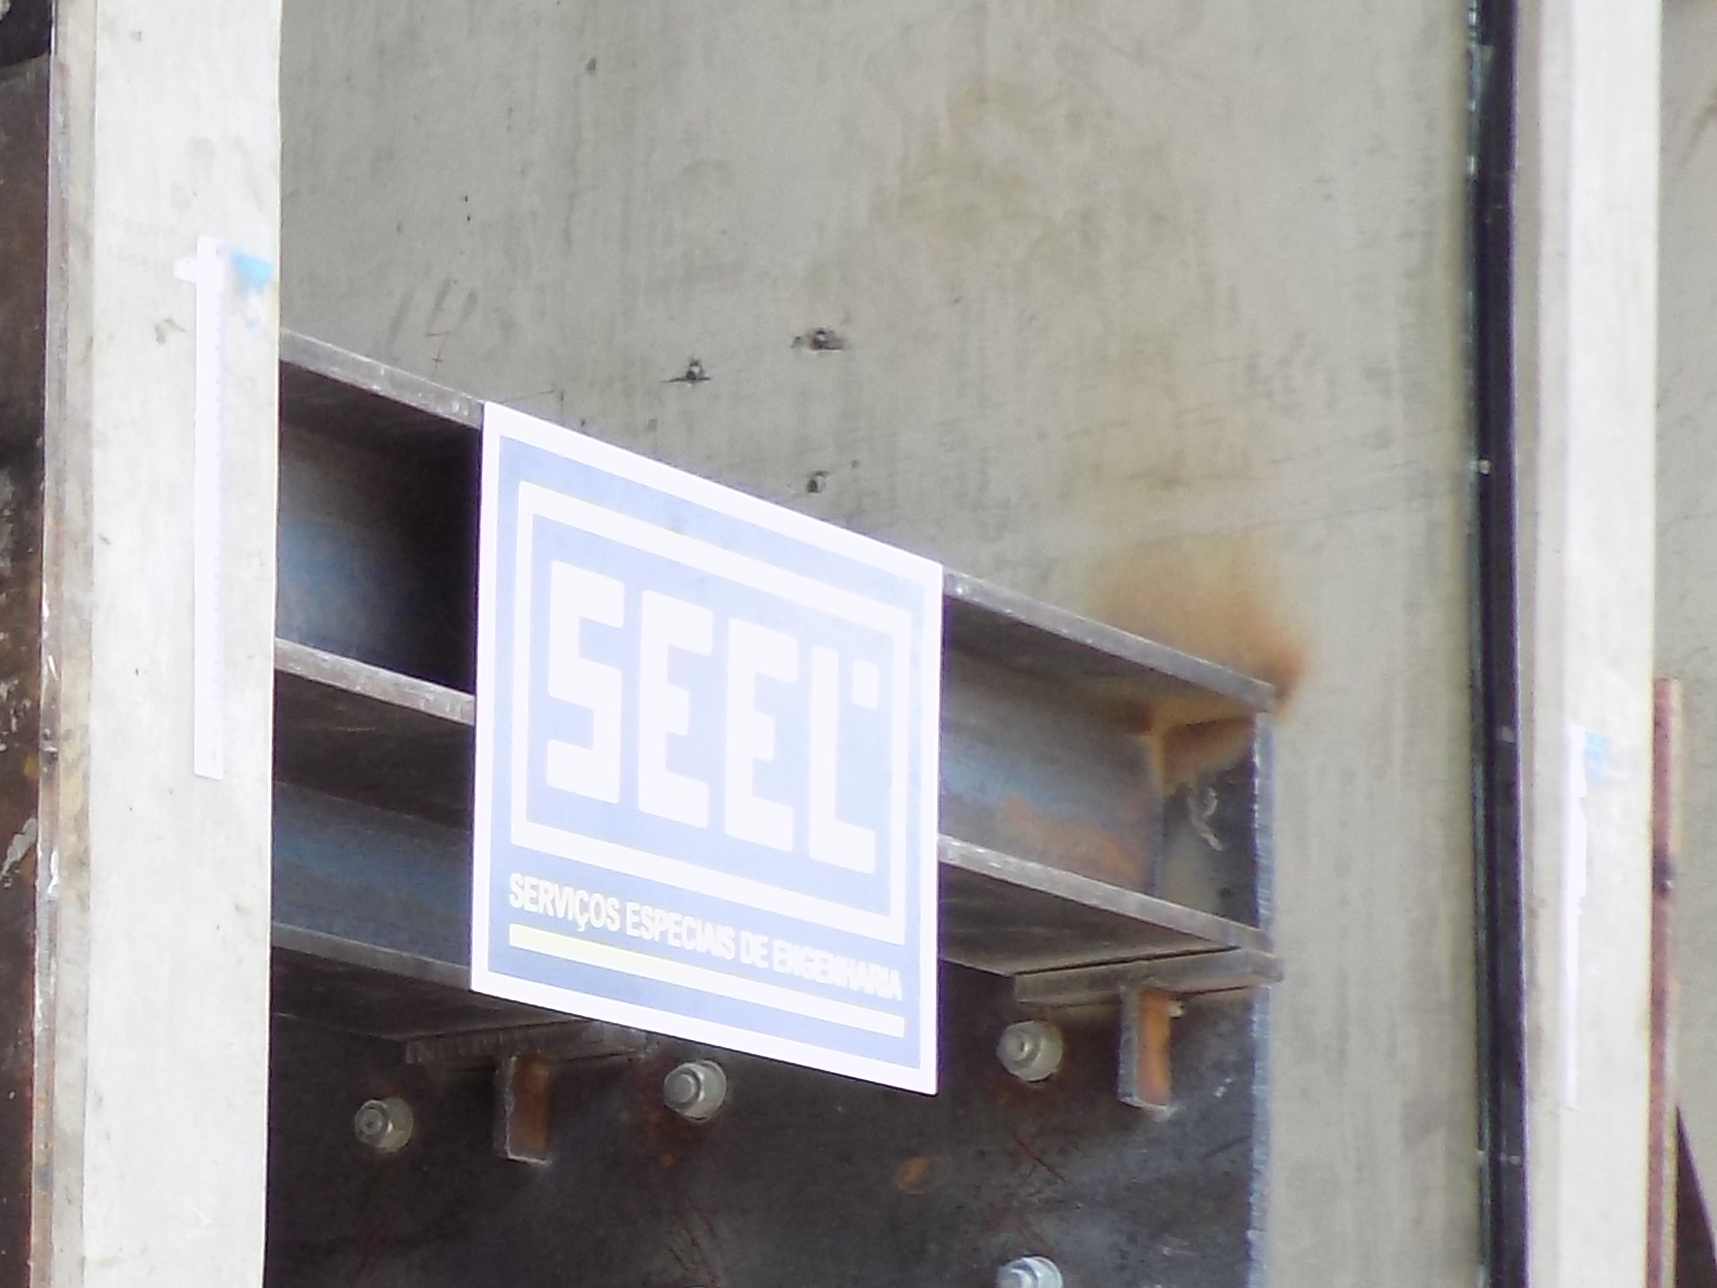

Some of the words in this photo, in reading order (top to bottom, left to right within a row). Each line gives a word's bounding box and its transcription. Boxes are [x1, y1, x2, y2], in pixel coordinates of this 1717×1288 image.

[546, 560, 877, 874] SEEL
[508, 871, 621, 933] SERVIÇOS
[625, 902, 736, 961] ESPECIAIS
[739, 929, 769, 969] DE
[772, 938, 903, 1001] ENGENHARIA
